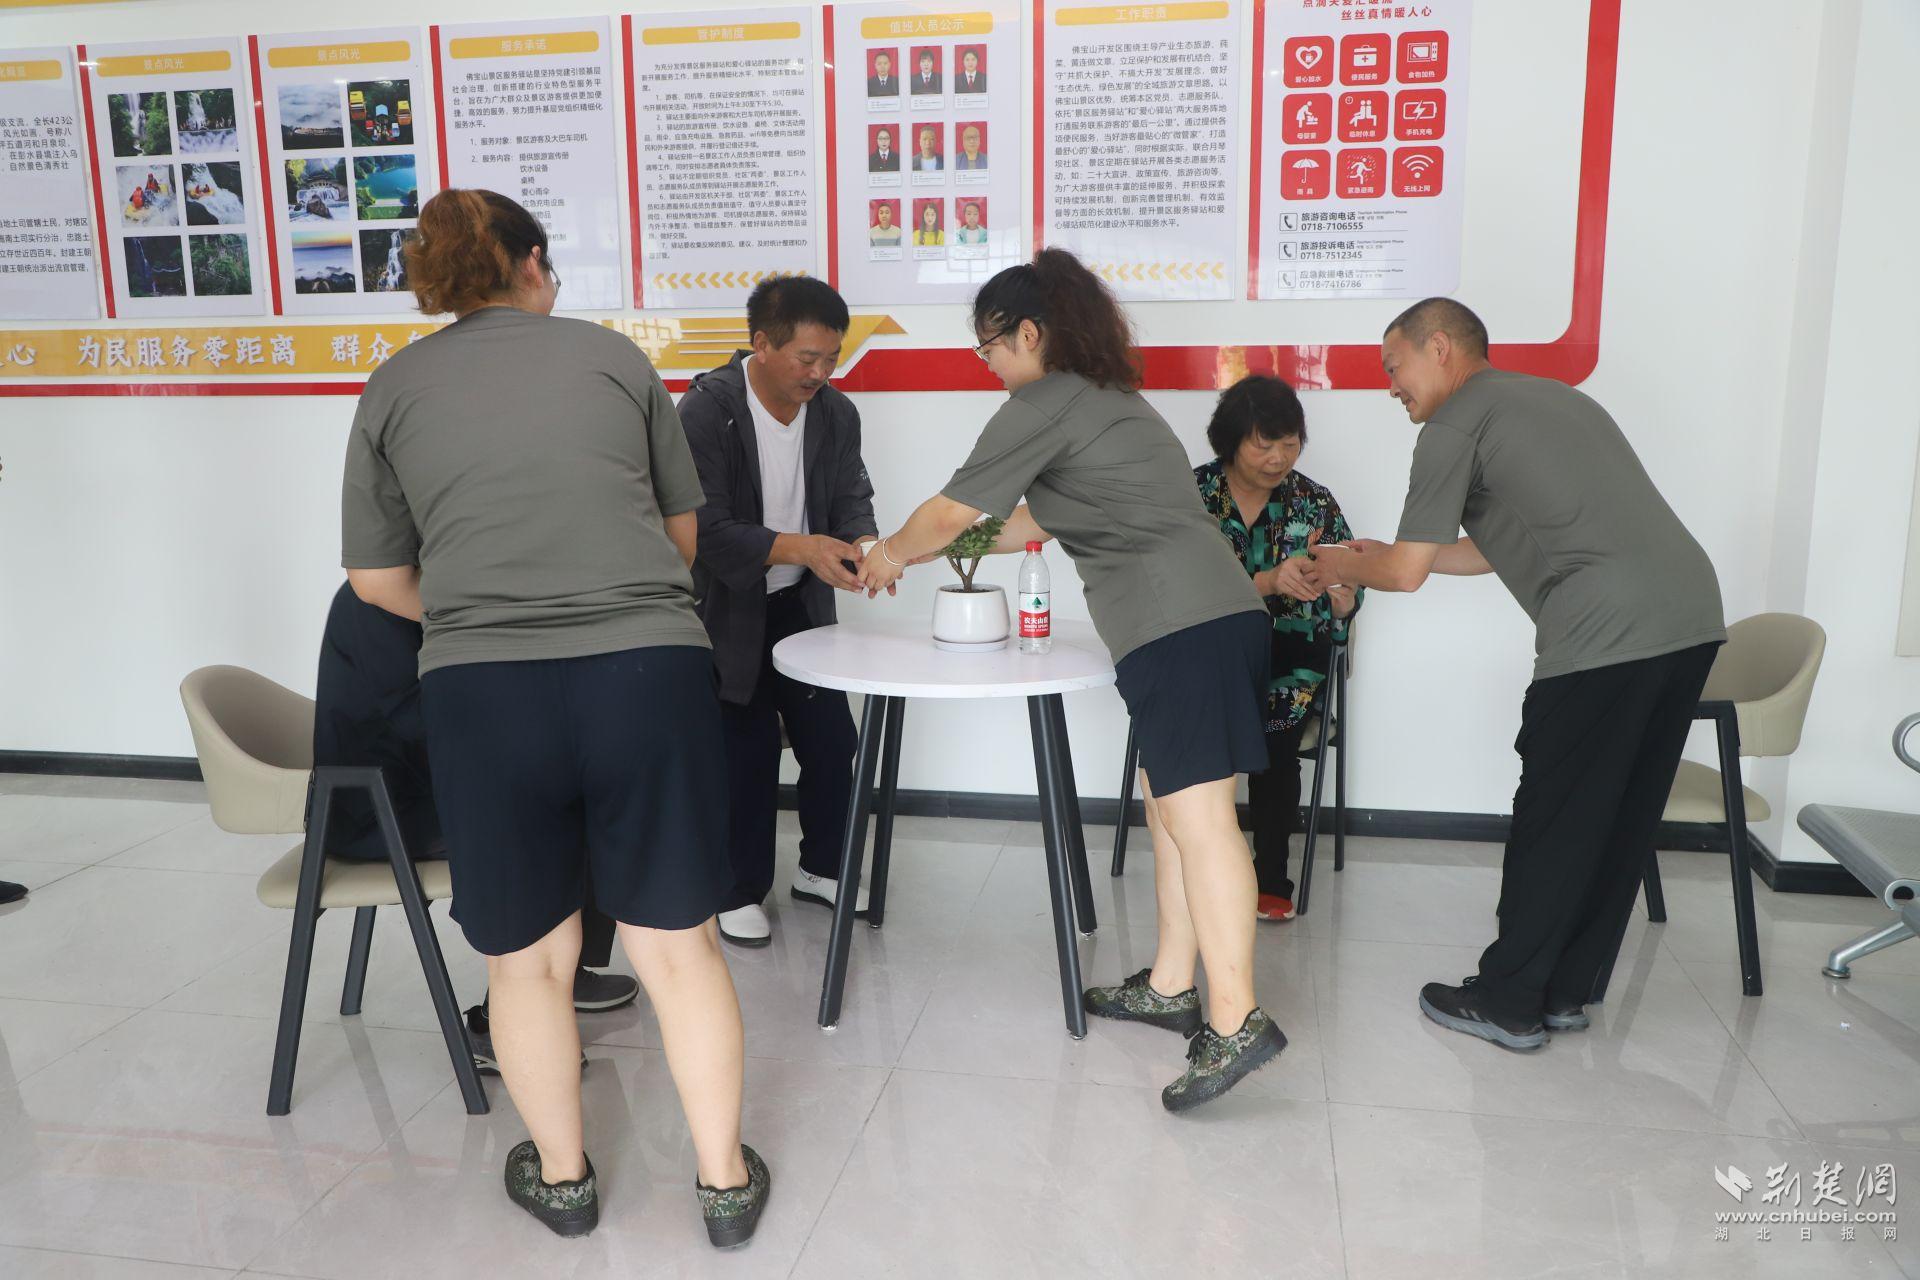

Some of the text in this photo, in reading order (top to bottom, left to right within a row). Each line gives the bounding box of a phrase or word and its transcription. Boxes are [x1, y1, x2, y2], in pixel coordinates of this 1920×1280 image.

[1115, 6, 1168, 21] 工作职责
[1341, 6, 1432, 21] 丝丝真情暖人心
[890, 17, 965, 33] 值班人员公示
[697, 27, 745, 41] 管护制度
[501, 38, 547, 52] 服务承诺
[317, 47, 361, 61] 景点风光
[143, 57, 185, 71] 景点风光
[1407, 70, 1436, 79] 食物加热
[1349, 129, 1376, 138] 临时休息
[1405, 128, 1433, 136] 手机充电
[1403, 185, 1431, 193] 无线上网
[1301, 211, 1356, 221] 旅游咨询电话
[1301, 222, 1364, 231] 0718-7106555
[1300, 241, 1355, 250] 旅游投诉电话
[1300, 251, 1363, 260] 0718-7512345
[1299, 270, 1354, 279] 应急救援电话
[1299, 280, 1362, 289] 0718-7416786
[0, 344, 37, 367] 心
[77, 333, 296, 369] 为民服务零距离
[331, 333, 426, 369] 群众
